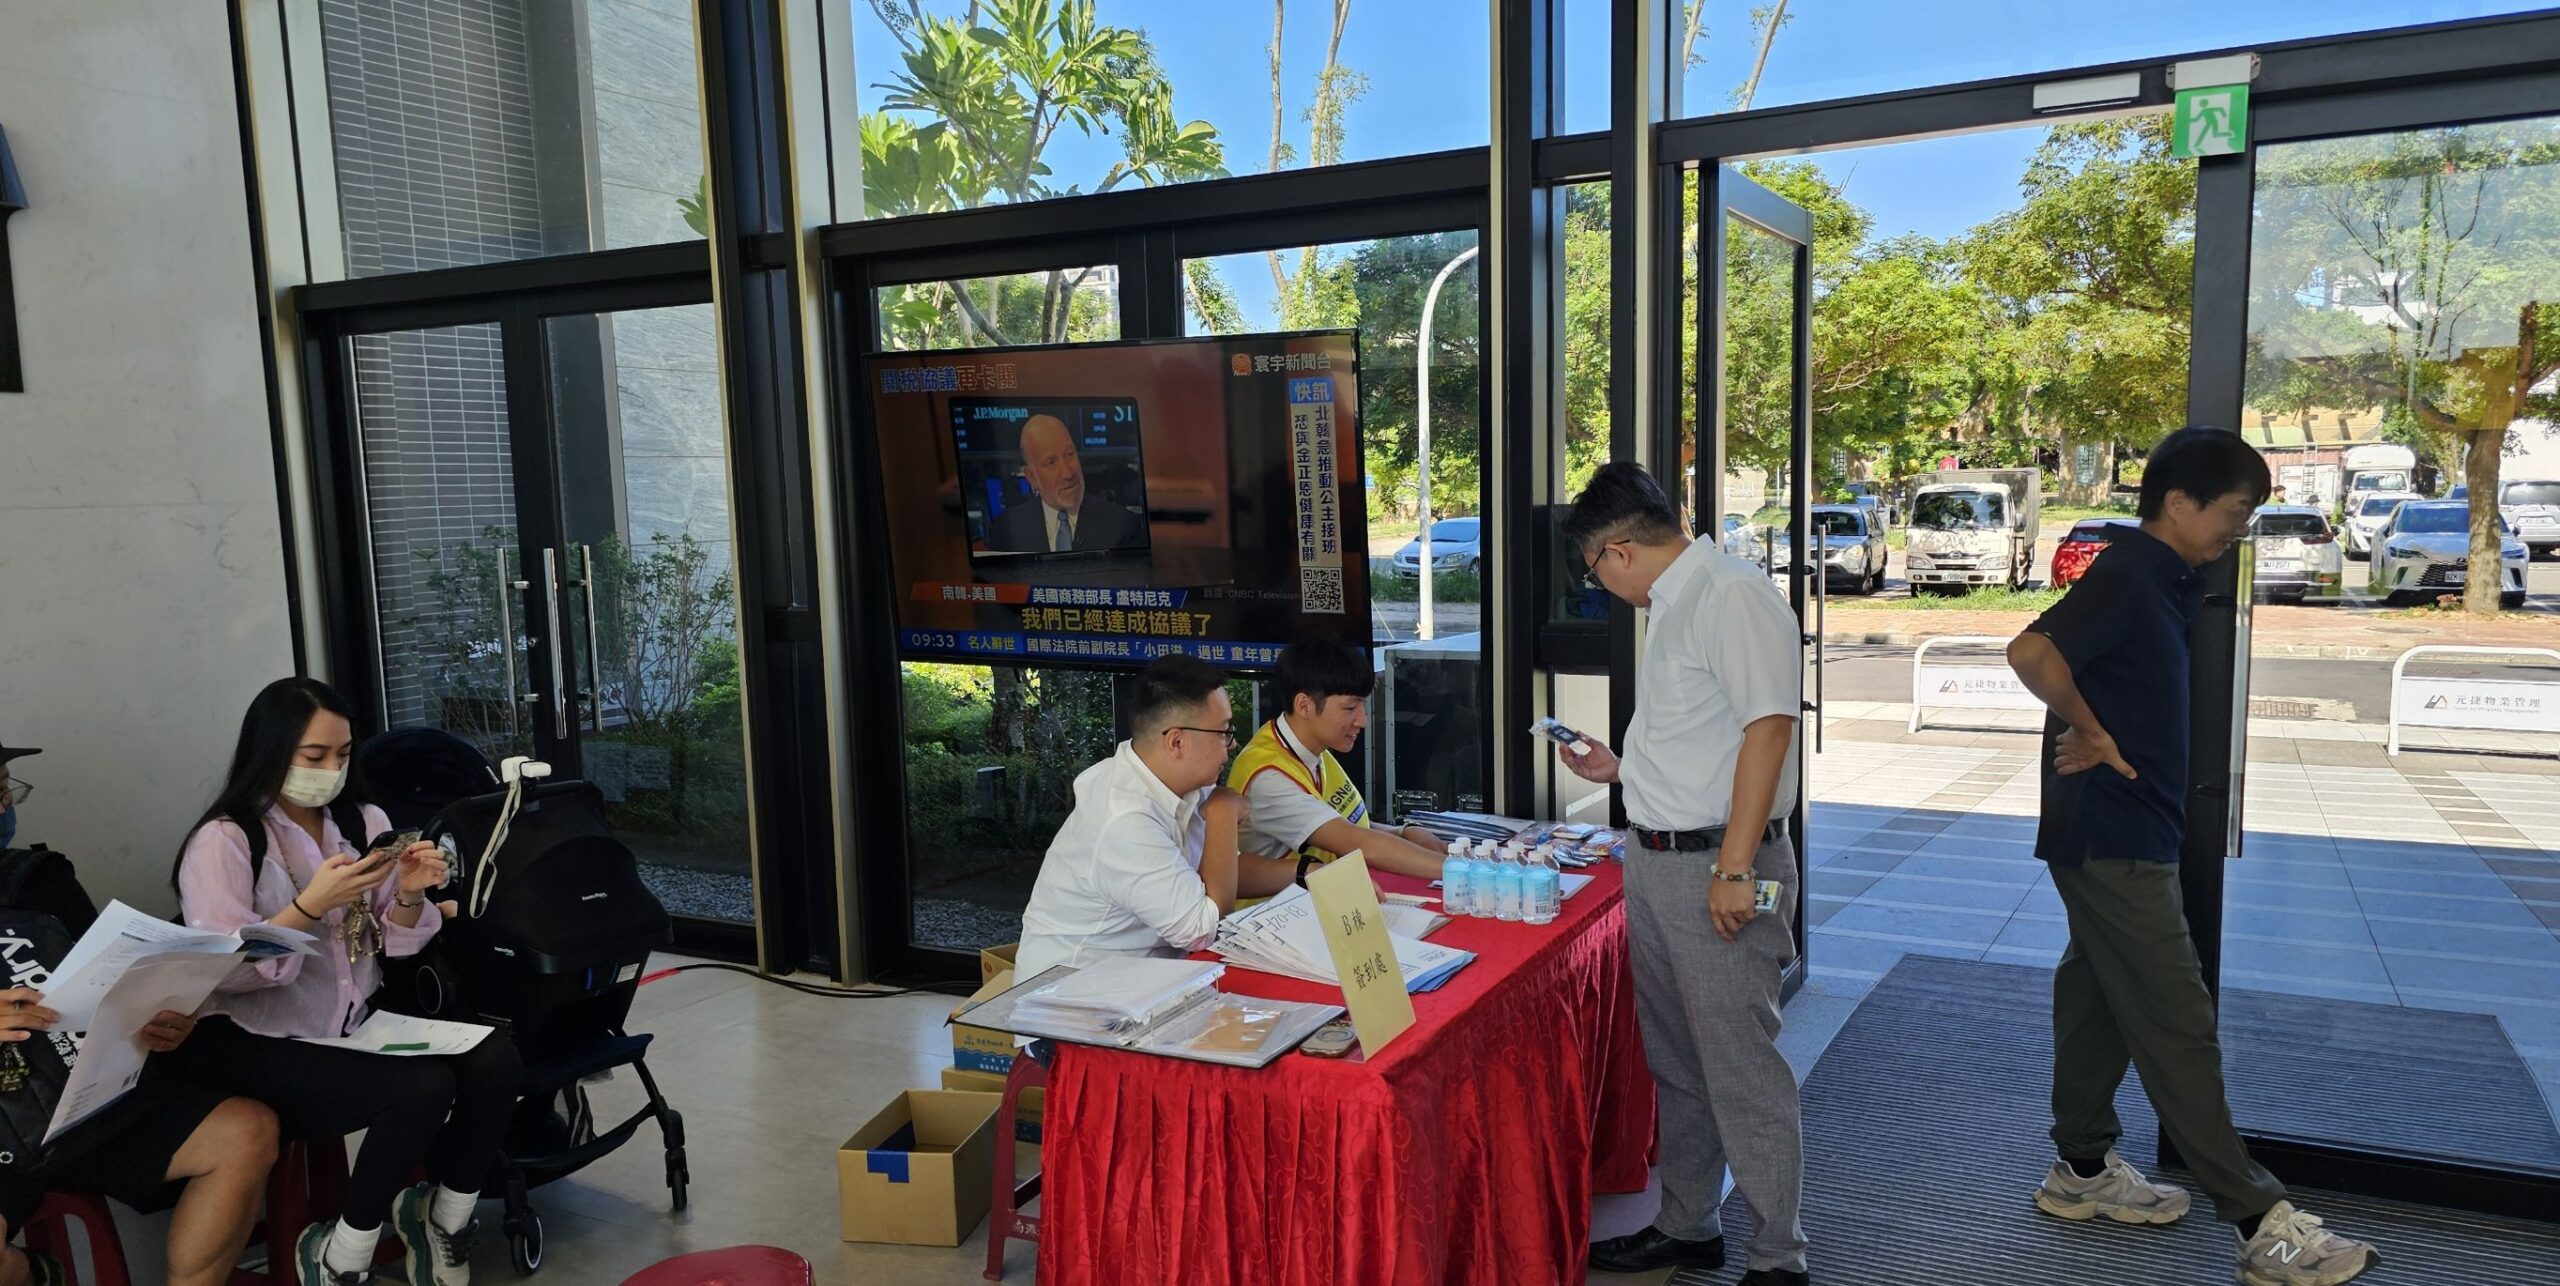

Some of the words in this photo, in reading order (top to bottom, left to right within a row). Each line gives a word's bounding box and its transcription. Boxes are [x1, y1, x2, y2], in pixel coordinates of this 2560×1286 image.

[1254, 353, 1332, 373] 寰宇新聞台
[1294, 382, 1330, 402] 快訊
[973, 407, 1029, 422] J.P.Morgan
[1294, 414, 1316, 561] 恐與金正恩健康有關
[1315, 405, 1336, 554] 北韓急推動公主接班
[1032, 587, 1113, 606] 美國商務部長
[1116, 589, 1171, 608] 盧特尼克
[1021, 606, 1212, 637] 我們已經達成協議了
[912, 632, 956, 648] 09:33
[967, 636, 1016, 651] 名人辭世
[2264, 1239, 2304, 1265] N
